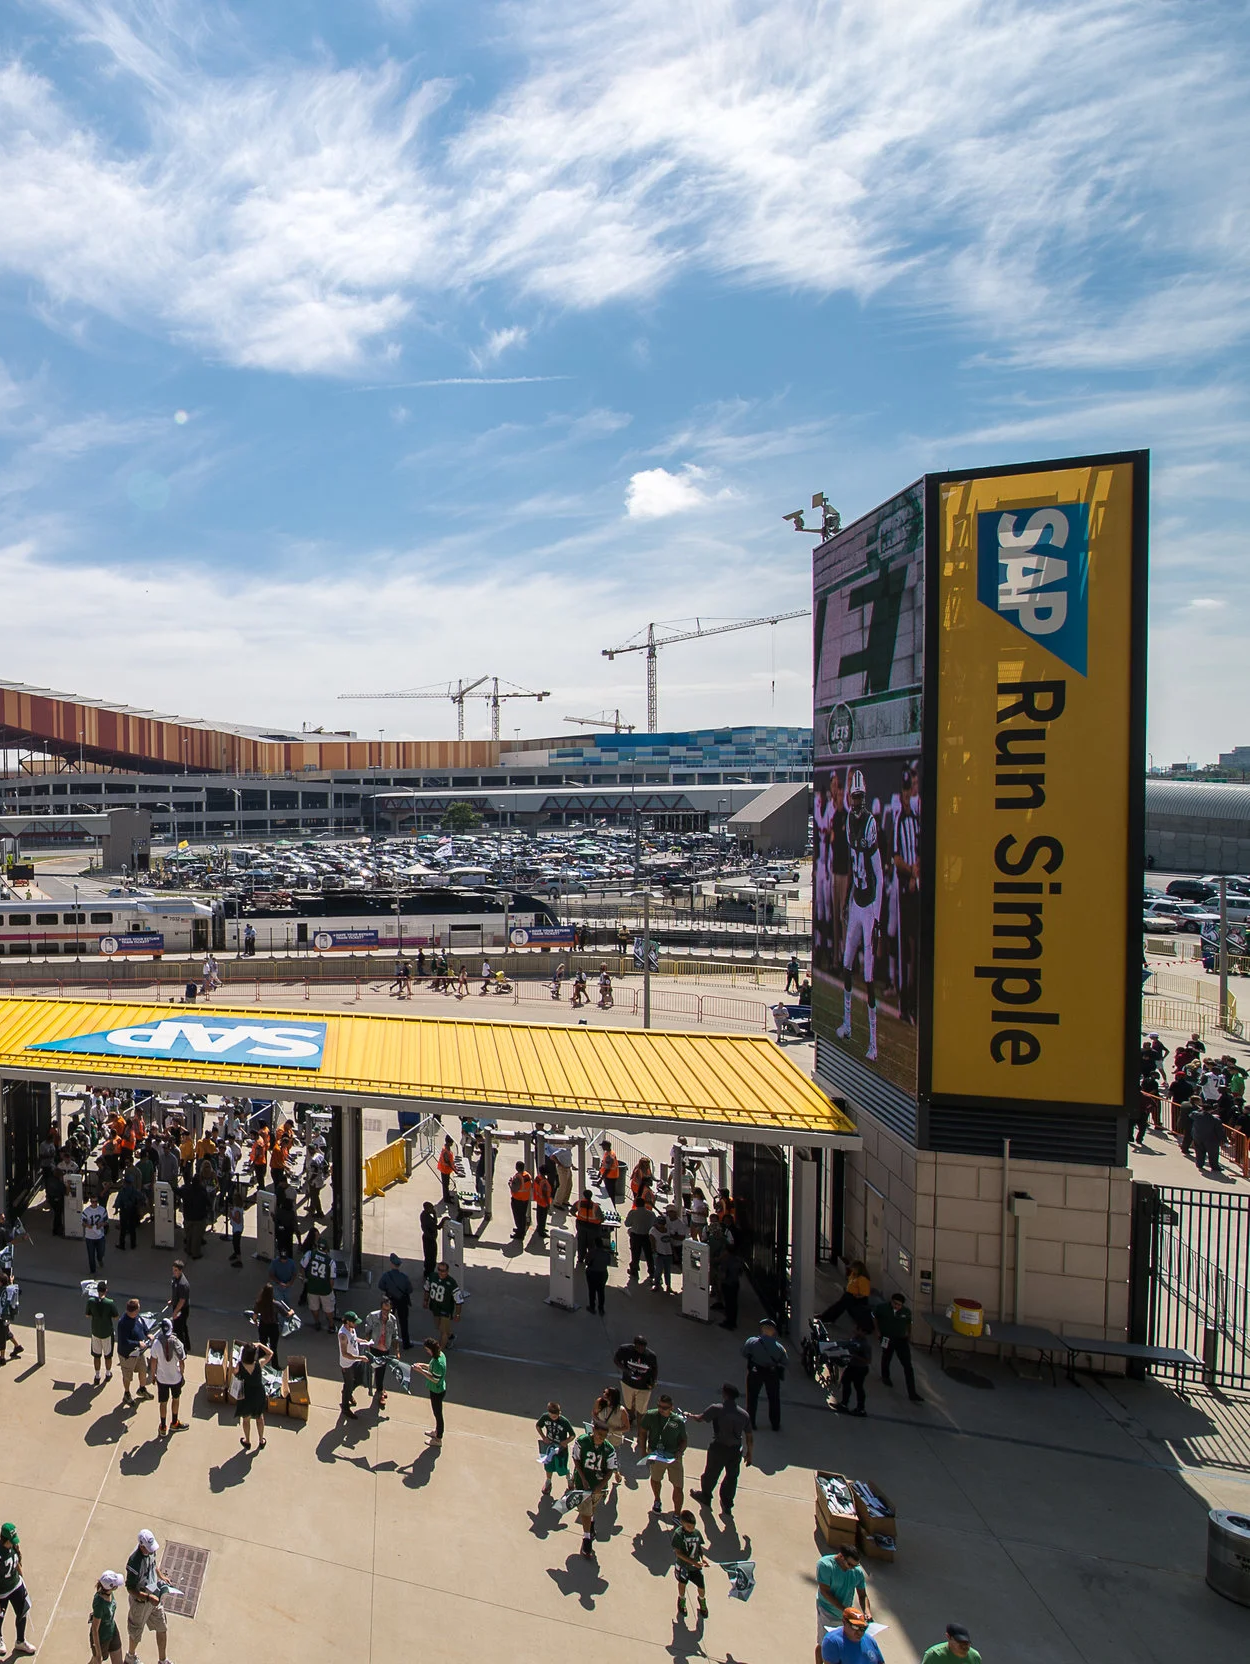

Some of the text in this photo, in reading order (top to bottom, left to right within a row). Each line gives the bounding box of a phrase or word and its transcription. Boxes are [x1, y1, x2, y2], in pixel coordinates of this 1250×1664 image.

[997, 508, 1070, 636] SAP
[831, 724, 849, 741] JETS
[974, 680, 1066, 1067] Run Simple
[107, 1020, 322, 1059] SAP
[310, 1260, 326, 1279] 24
[430, 1282, 445, 1303] 68
[584, 1451, 603, 1471] 21
